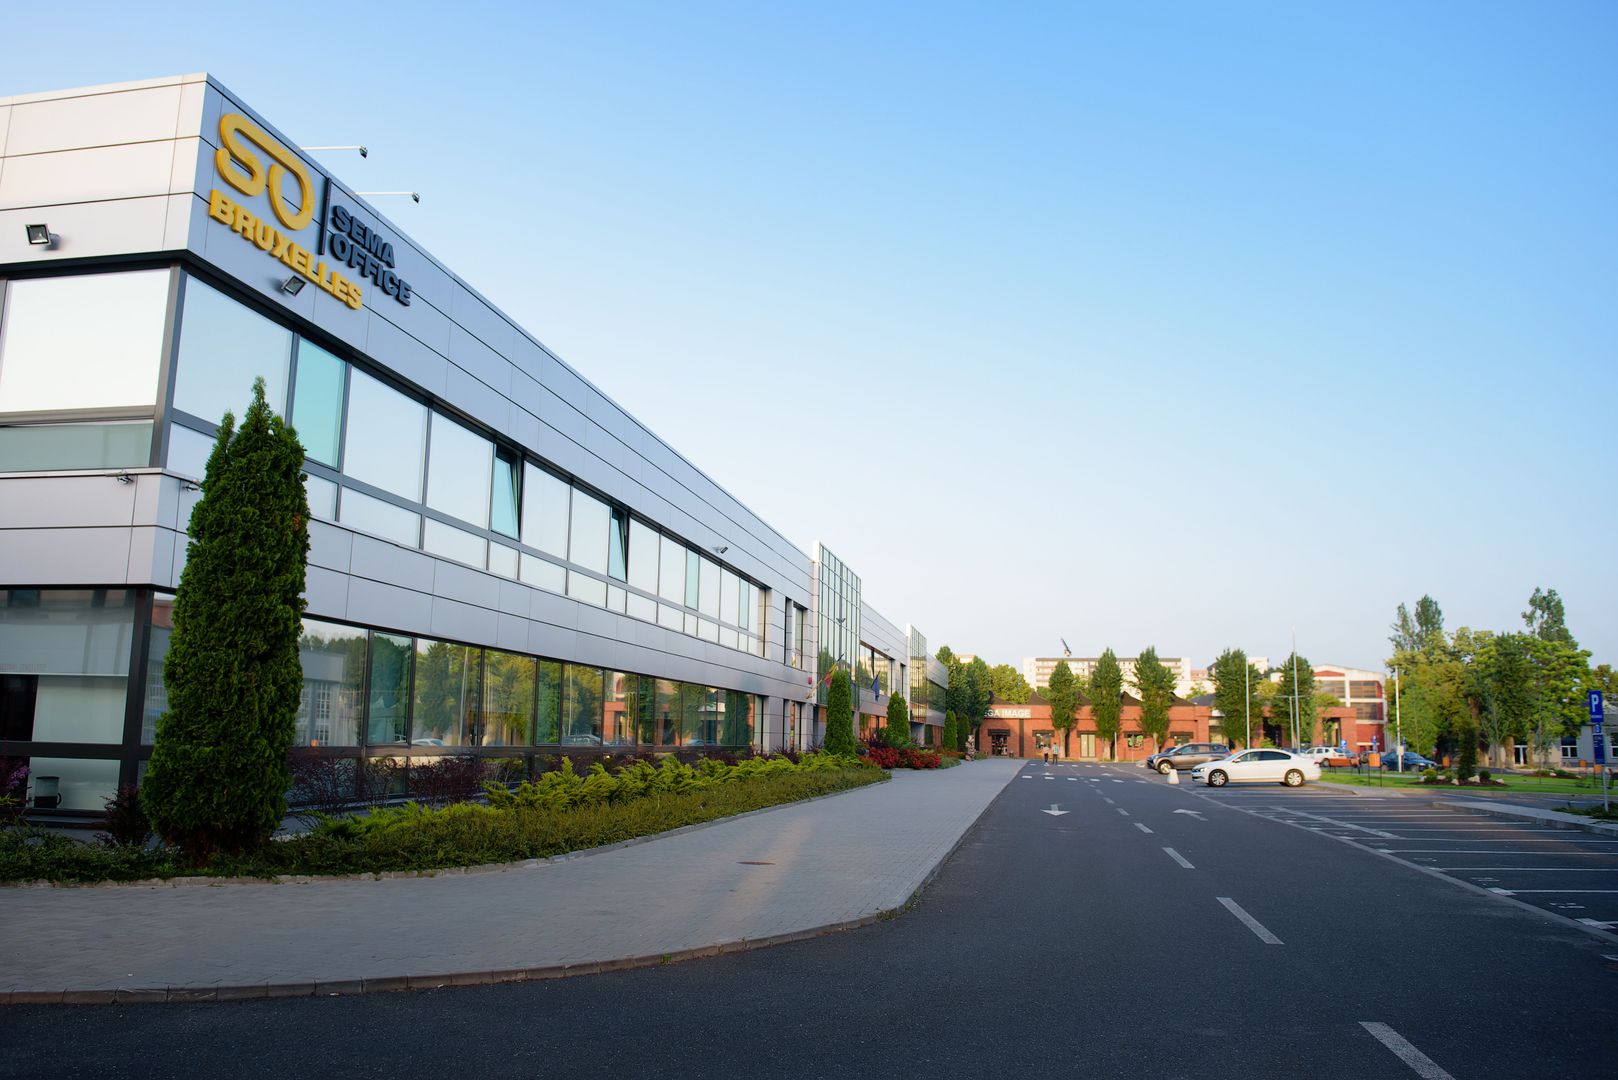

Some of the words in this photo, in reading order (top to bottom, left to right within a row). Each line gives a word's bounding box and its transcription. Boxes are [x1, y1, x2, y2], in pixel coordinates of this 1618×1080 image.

[216, 113, 314, 230] SO
[209, 189, 363, 310] BRUXELLES
[331, 233, 412, 306] OFFICE
[332, 204, 396, 268] SEMA
[1002, 709, 1030, 717] IMAGE
[1591, 694, 1599, 712] P
